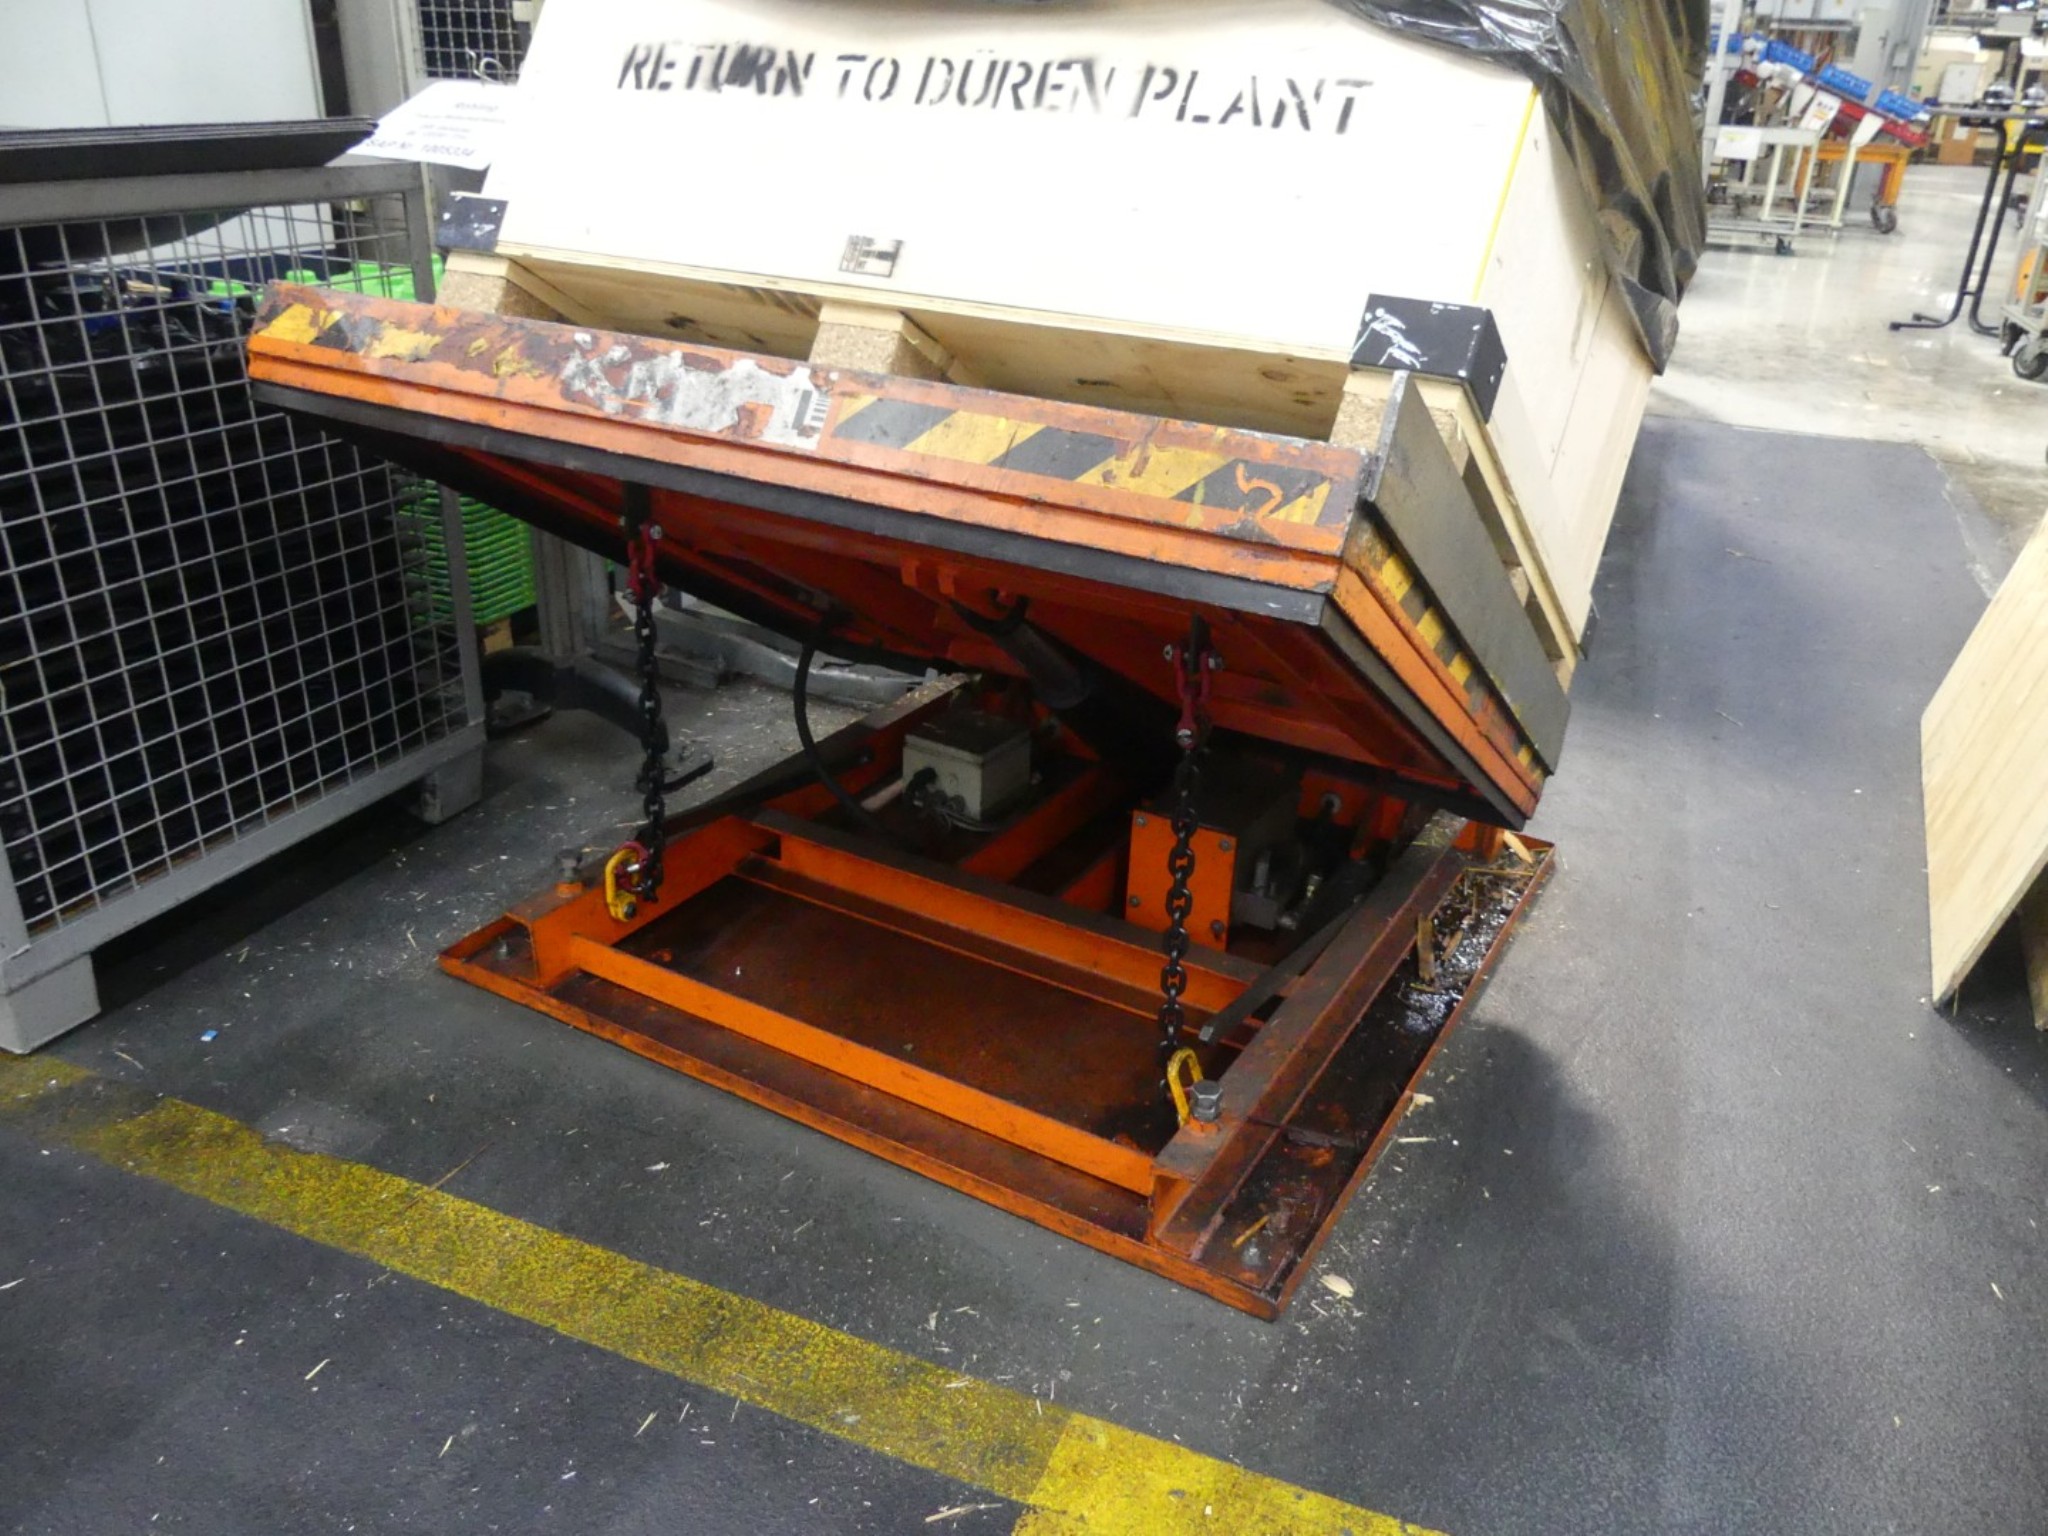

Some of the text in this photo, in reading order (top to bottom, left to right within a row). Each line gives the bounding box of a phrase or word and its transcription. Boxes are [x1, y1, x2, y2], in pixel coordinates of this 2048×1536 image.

[617, 42, 1374, 135] RETURN TO DÜREN PLANT
